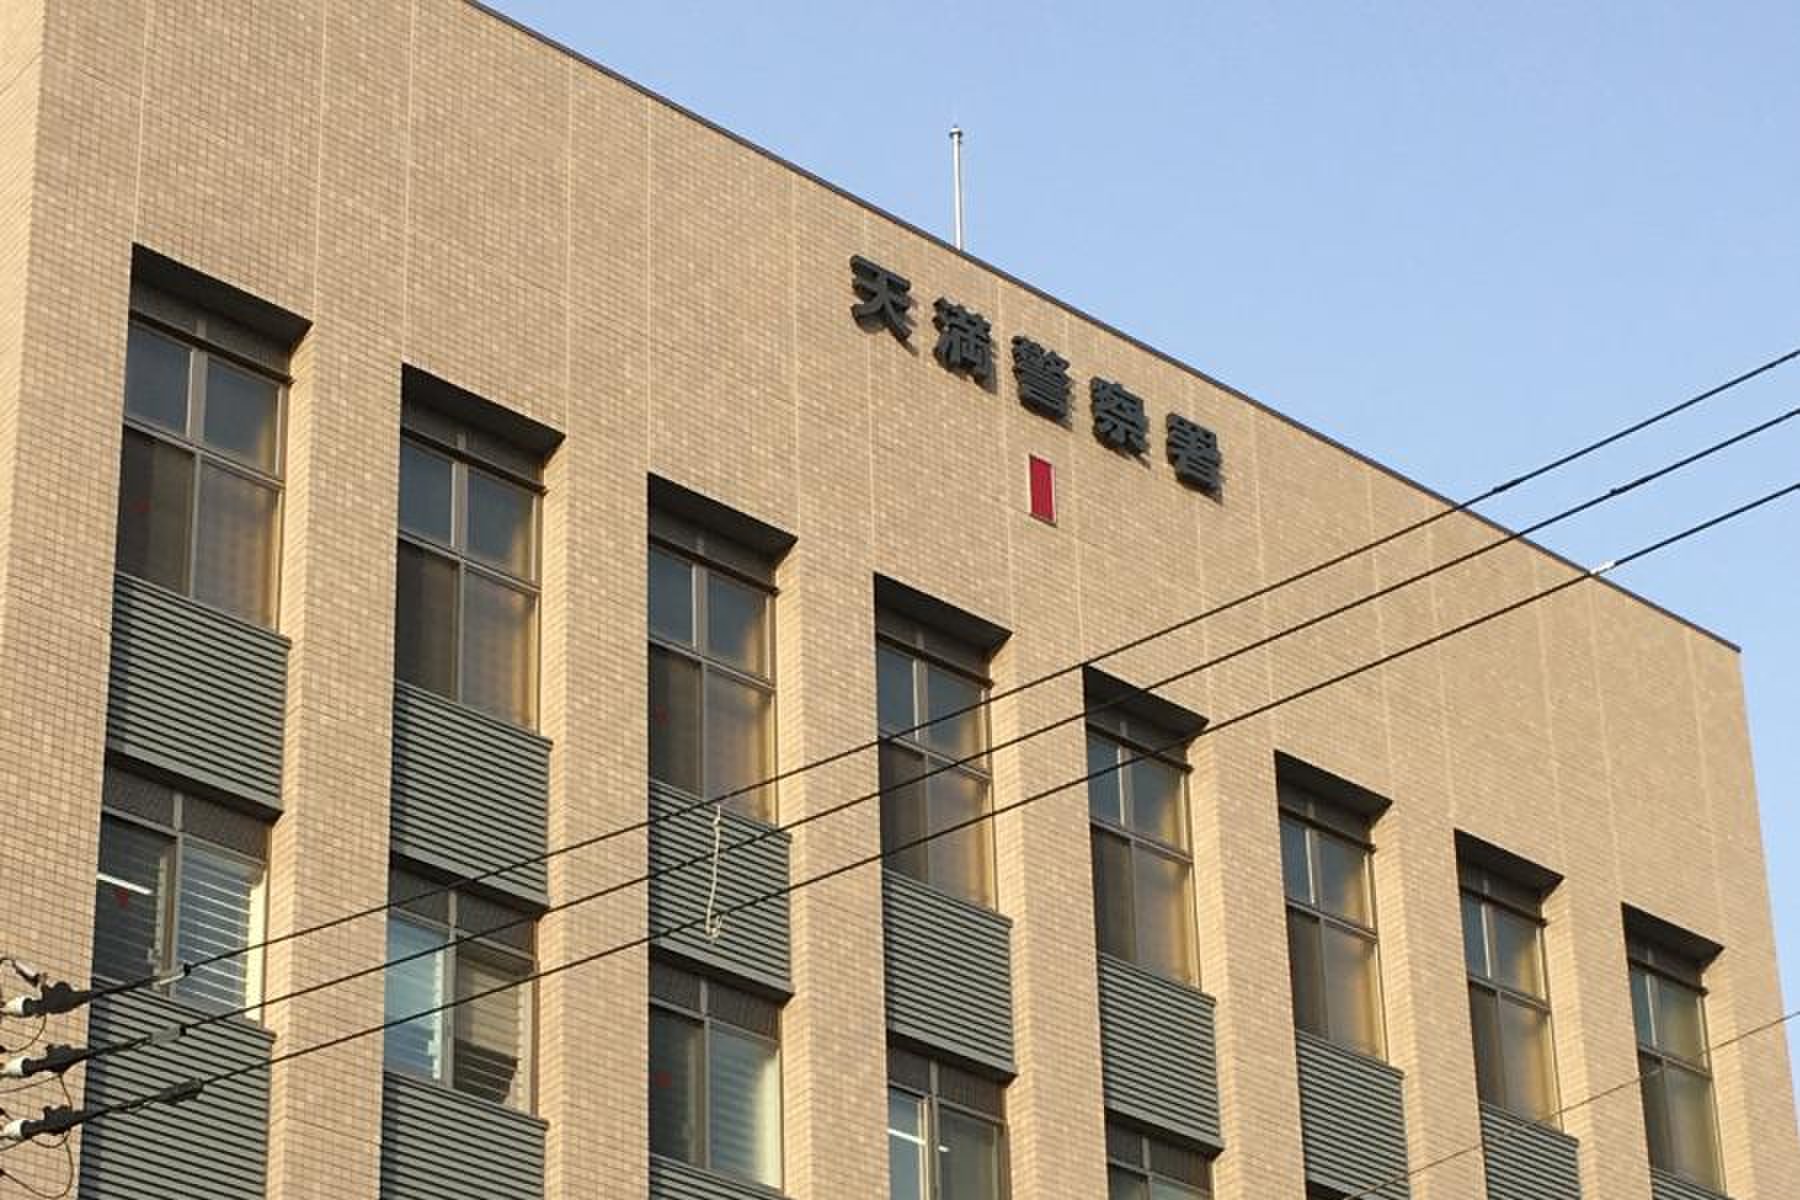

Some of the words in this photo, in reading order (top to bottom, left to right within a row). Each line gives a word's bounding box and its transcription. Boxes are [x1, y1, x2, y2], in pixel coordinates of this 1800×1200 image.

[850, 254, 1221, 500] 天満警察署
